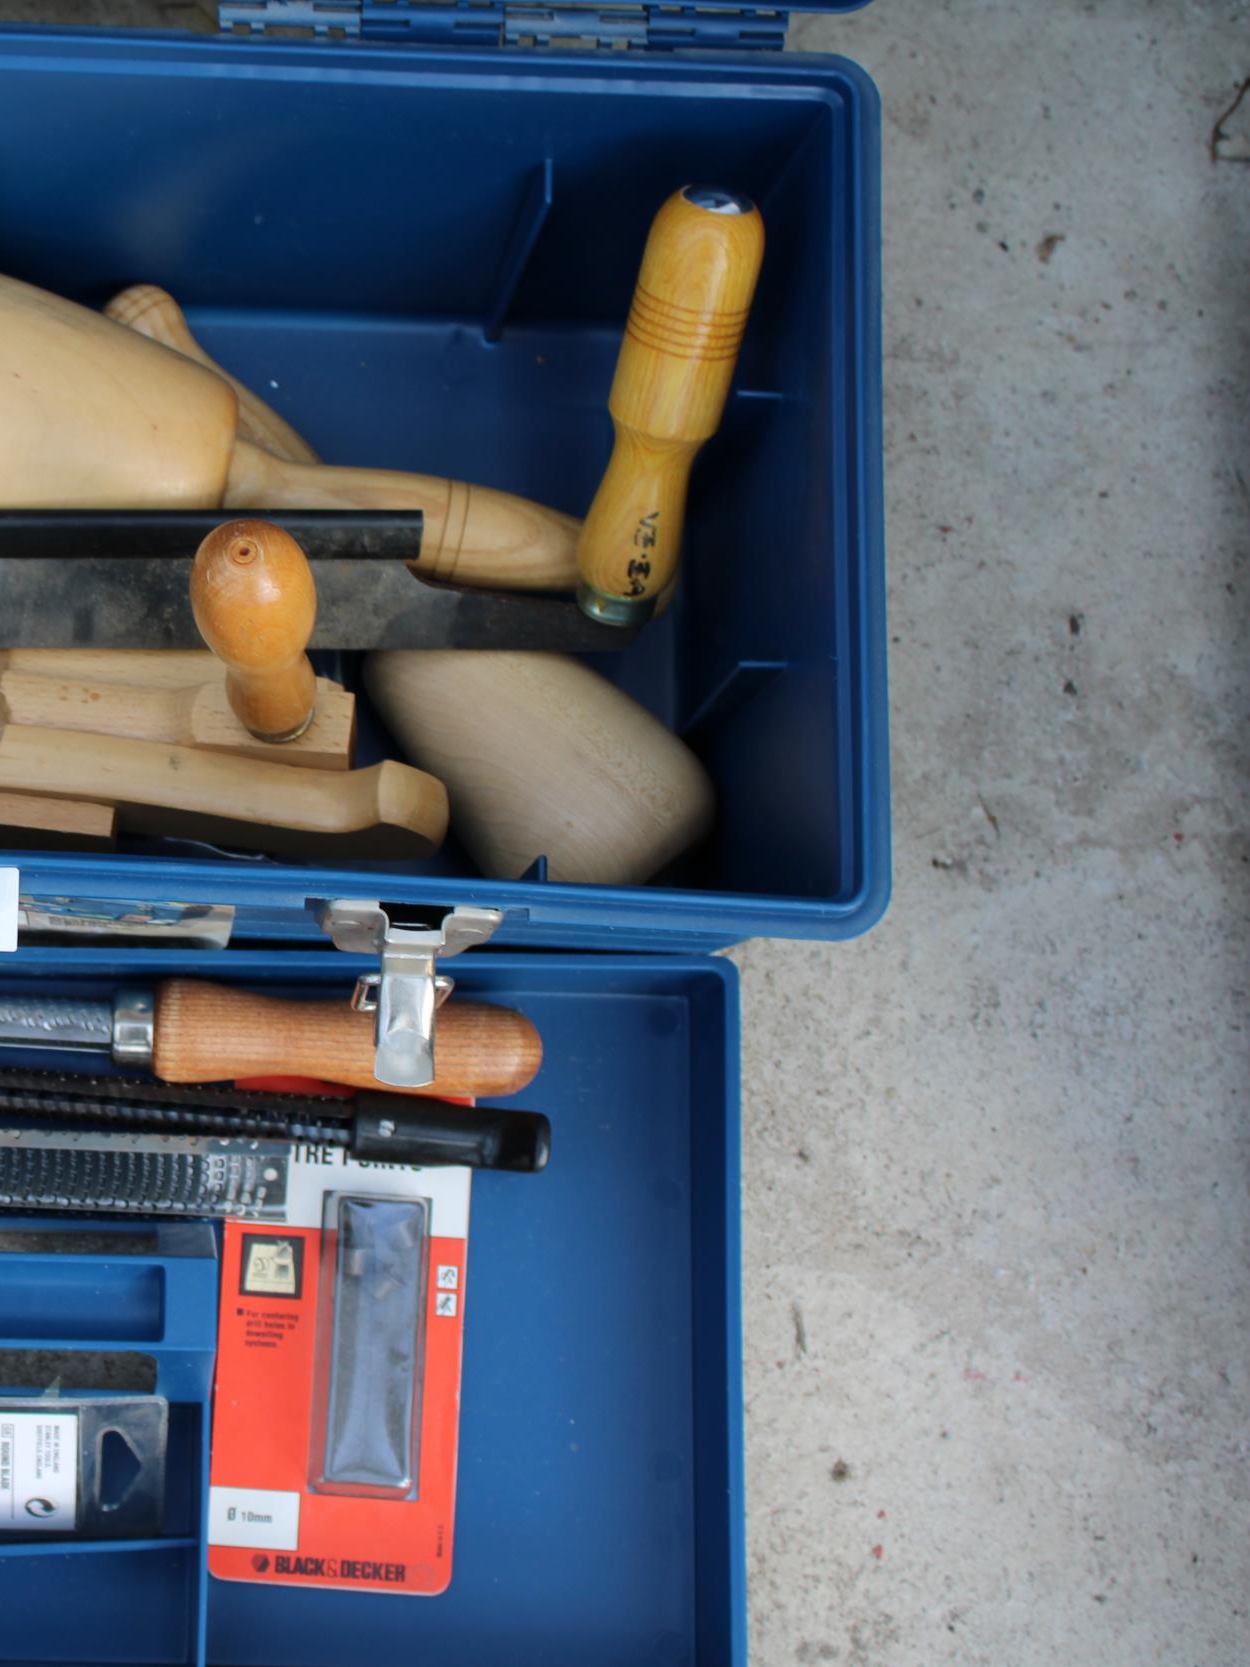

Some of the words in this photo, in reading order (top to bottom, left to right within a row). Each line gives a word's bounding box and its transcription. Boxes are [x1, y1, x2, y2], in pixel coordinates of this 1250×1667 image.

[1, 1441, 11, 1467] ROUND
[0, 1468, 10, 1490] BLADE
[241, 1511, 273, 1524] 10mm
[274, 1555, 406, 1583] BLACK&DECKER
